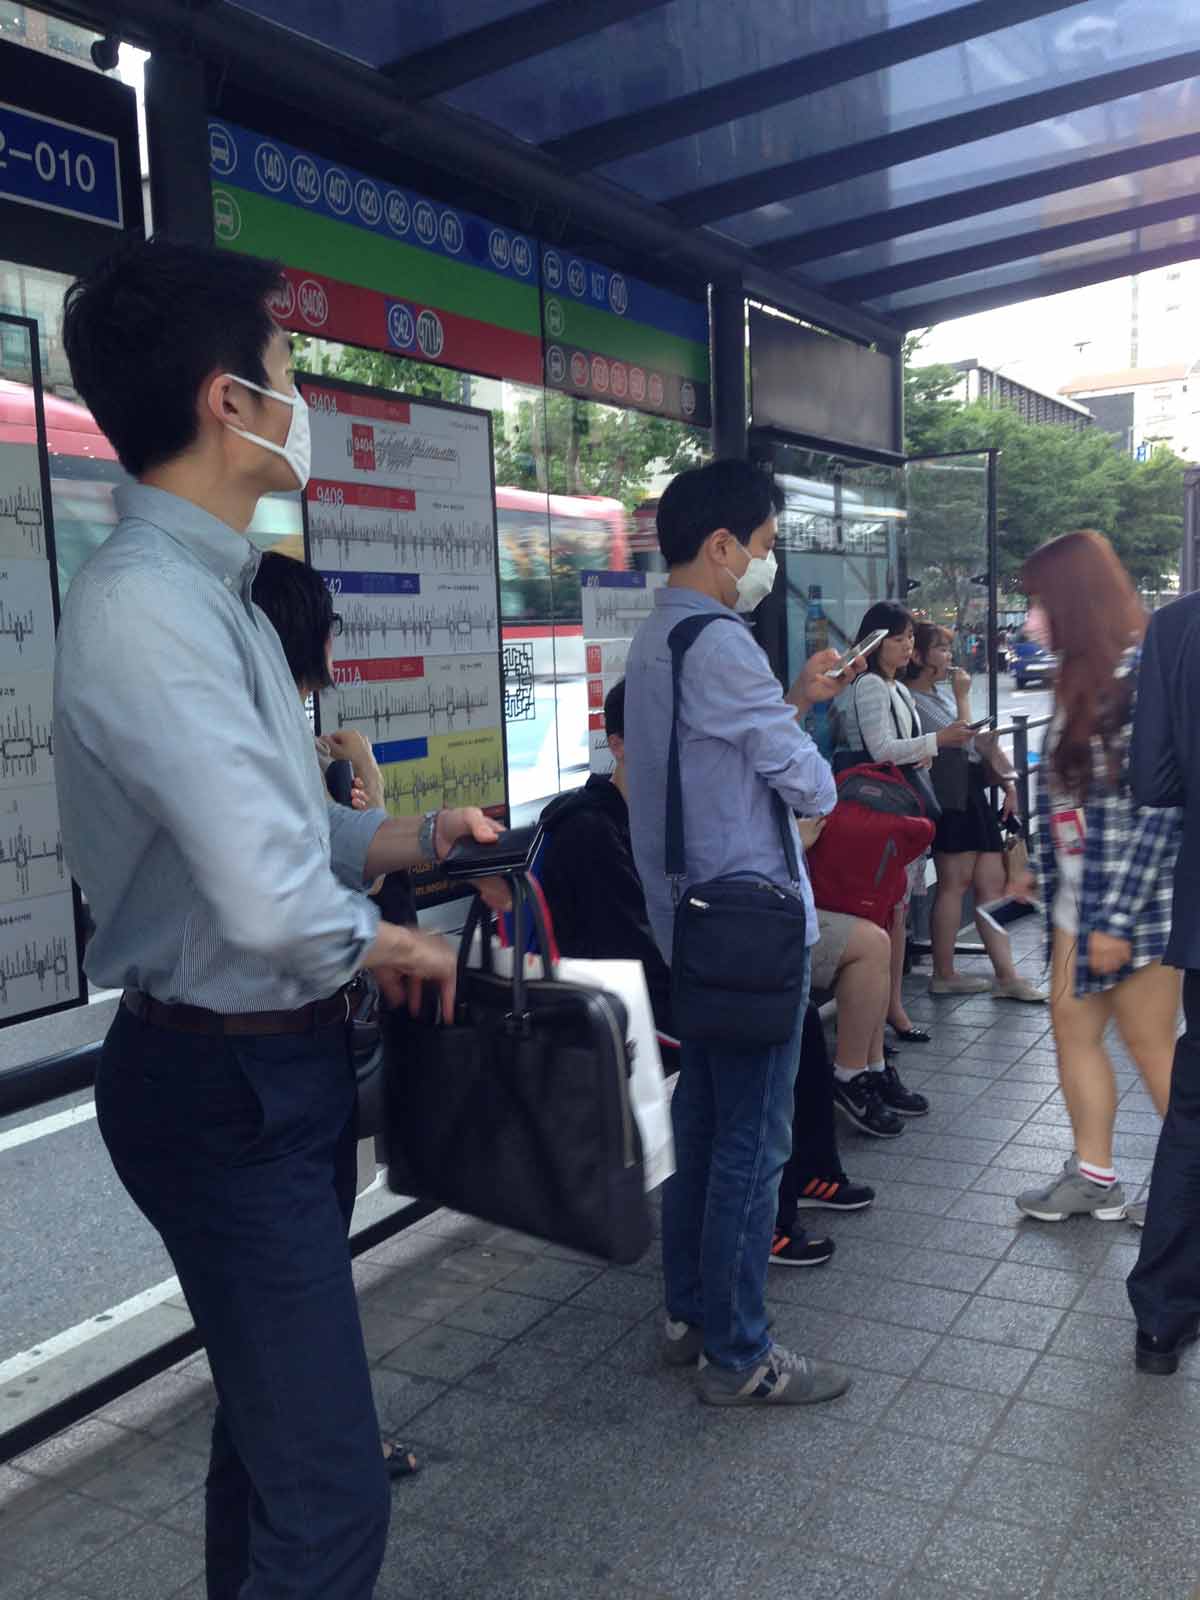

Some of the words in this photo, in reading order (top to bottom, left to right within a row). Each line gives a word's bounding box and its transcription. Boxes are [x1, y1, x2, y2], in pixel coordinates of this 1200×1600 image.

[261, 150, 282, 183] 140
[296, 163, 317, 196] 402
[329, 175, 348, 207] 407
[301, 287, 325, 319] 9408
[308, 391, 338, 416] 9404
[315, 486, 344, 510] 9408
